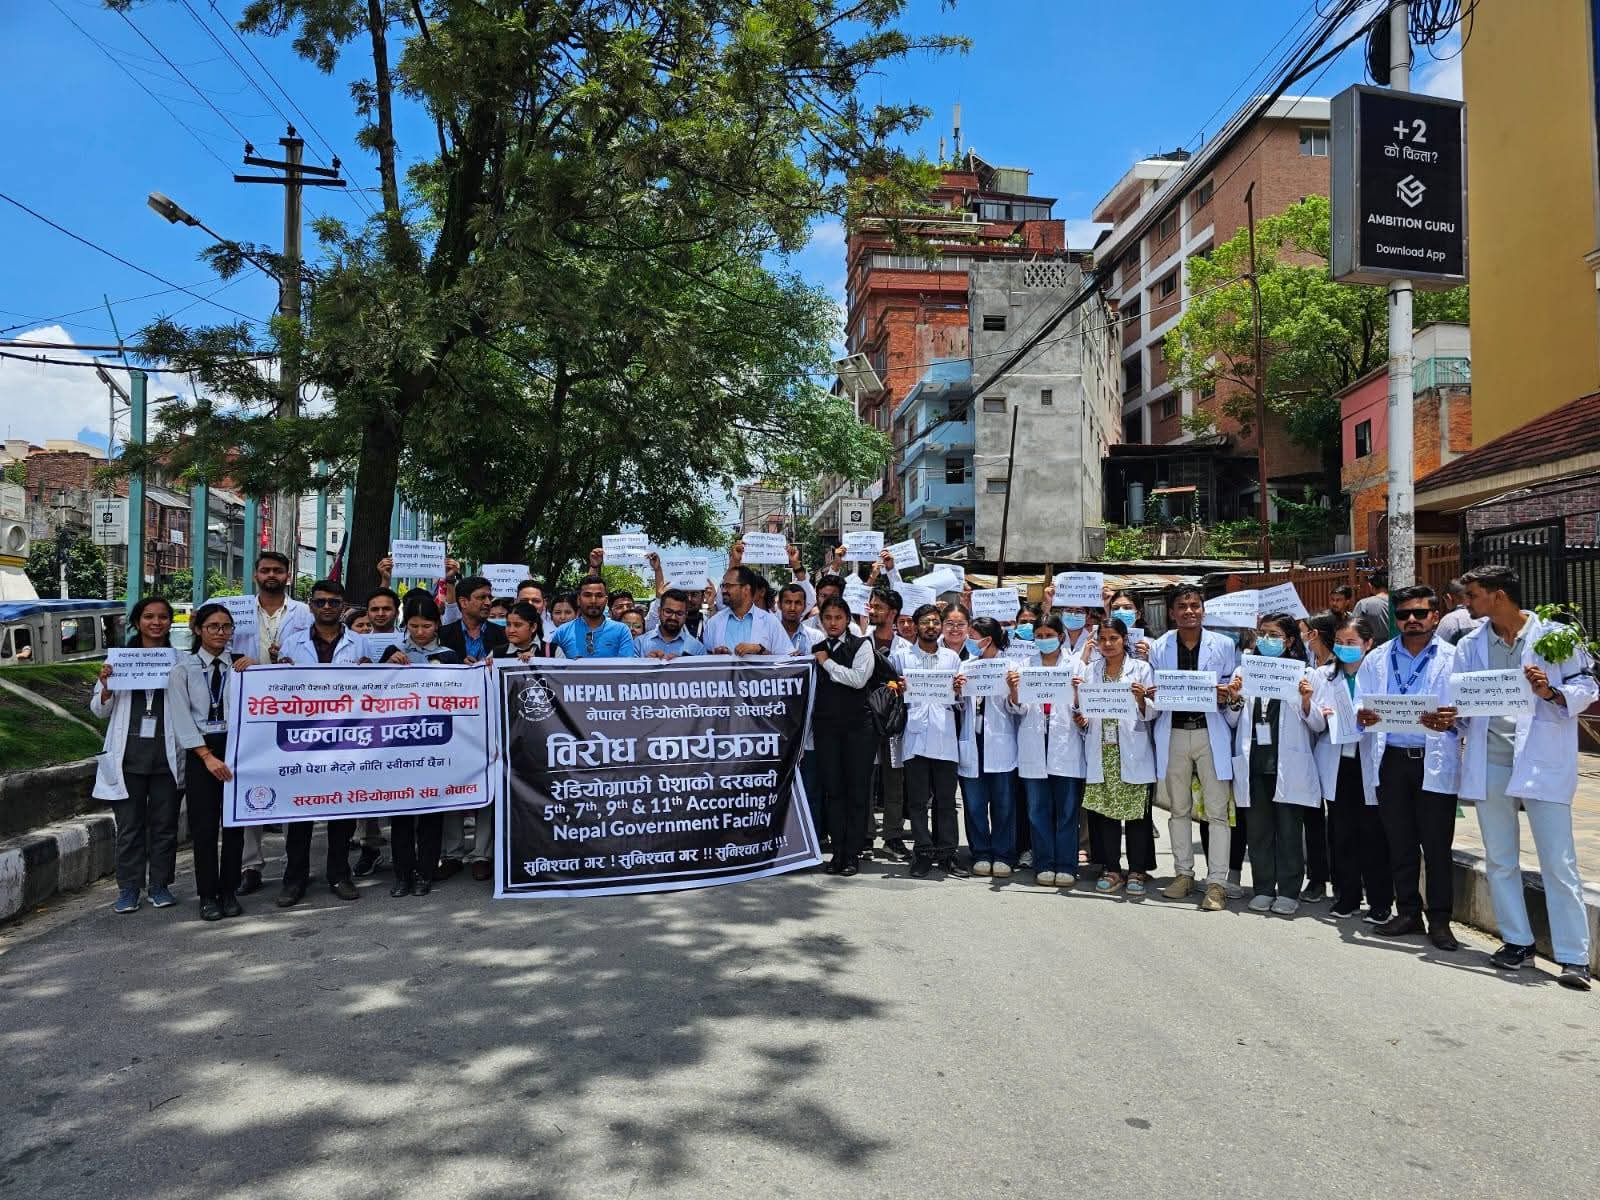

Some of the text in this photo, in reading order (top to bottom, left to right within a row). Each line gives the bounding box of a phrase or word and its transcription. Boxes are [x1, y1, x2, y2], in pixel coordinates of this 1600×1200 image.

[1393, 119, 1427, 143] +2
[1384, 143, 1438, 163] को चिन्ता?
[1368, 213, 1455, 233] AMBITION GURU
[1376, 243, 1446, 261] Download App
[564, 678, 803, 702] NEPAL RADIOLOGICAL SOCIETY
[248, 692, 480, 716] रेडियोग्राफी पेशाको पक्षमा
[586, 706, 627, 722] नेपाल
[631, 704, 730, 720] रेडियोलोजिकल
[380, 719, 444, 742] प्रदर्शन
[546, 728, 780, 768] विरोध कार्यक्रम
[278, 764, 302, 776] हाम्रो
[306, 763, 326, 774] पेशा
[330, 761, 356, 775] मेट्ने
[360, 760, 382, 771] नीति
[386, 757, 424, 770] स्वीकार्य
[428, 758, 444, 768] छैन
[292, 792, 342, 806] सरकारी
[348, 787, 414, 803] रेडियोग्राफी
[444, 784, 477, 796] नेपाल
[550, 770, 778, 801] रेडियोग्राफी पेशाको दरबन्दी
[632, 798, 646, 814] &
[686, 794, 766, 812] According
[768, 793, 778, 804] to
[553, 810, 772, 842] Nepal Government Facility
[584, 856, 607, 868] गर
[678, 849, 699, 862] गर
